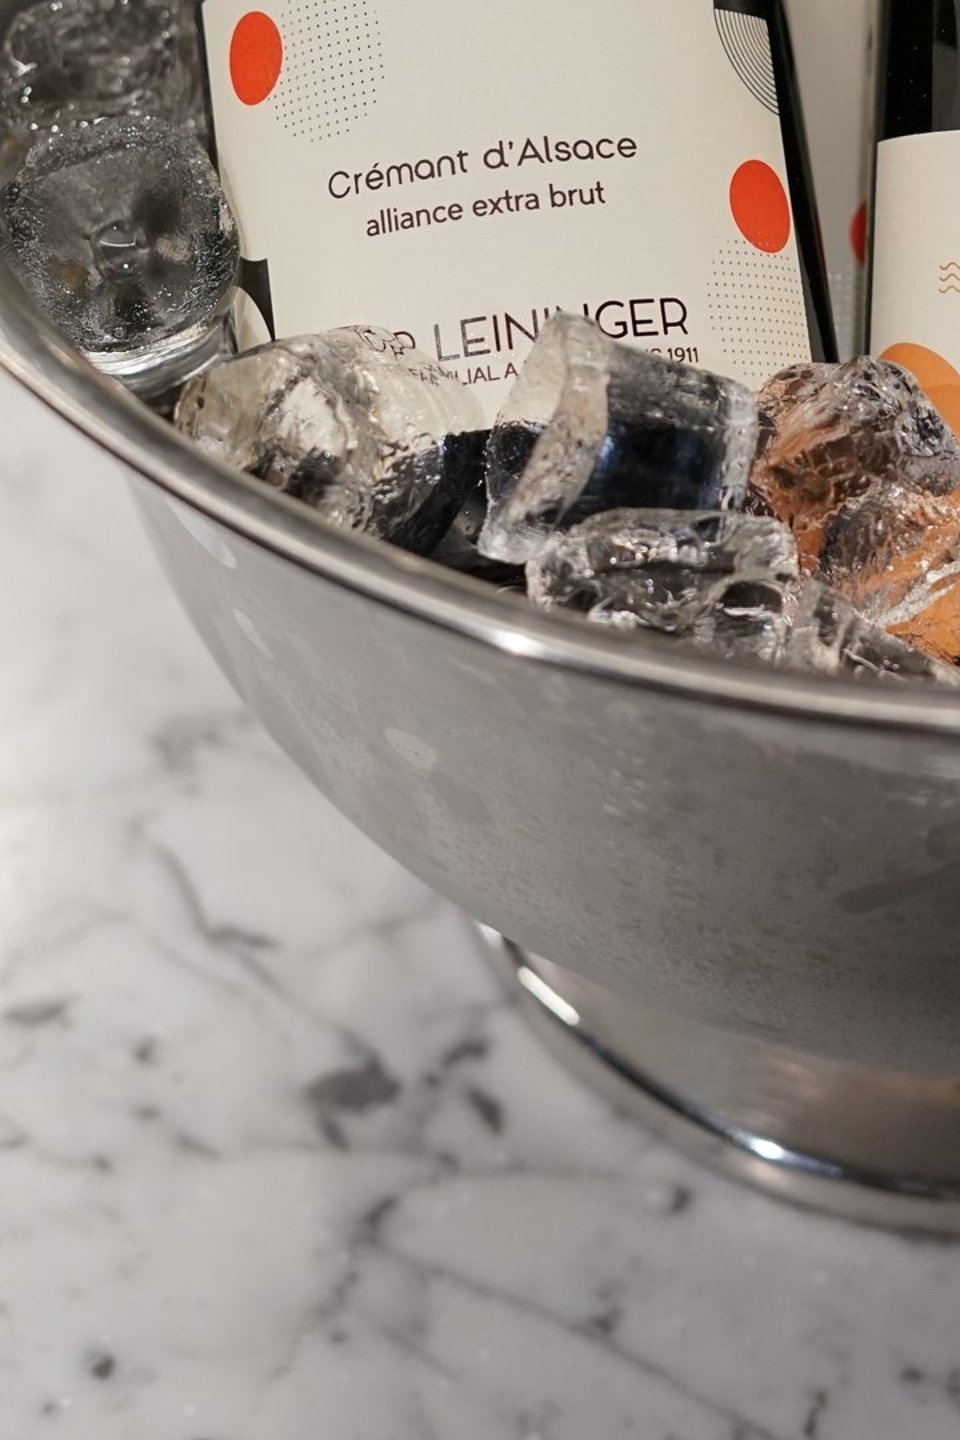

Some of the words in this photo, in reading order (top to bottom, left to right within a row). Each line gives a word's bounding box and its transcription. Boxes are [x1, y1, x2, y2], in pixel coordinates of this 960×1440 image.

[328, 148, 470, 200] Crémant
[482, 134, 638, 170] d'Alsace
[365, 201, 465, 238] alliance
[471, 189, 541, 216] extra
[548, 180, 607, 209] brut
[433, 296, 691, 362] LEINGER
[667, 345, 701, 364] 1911
